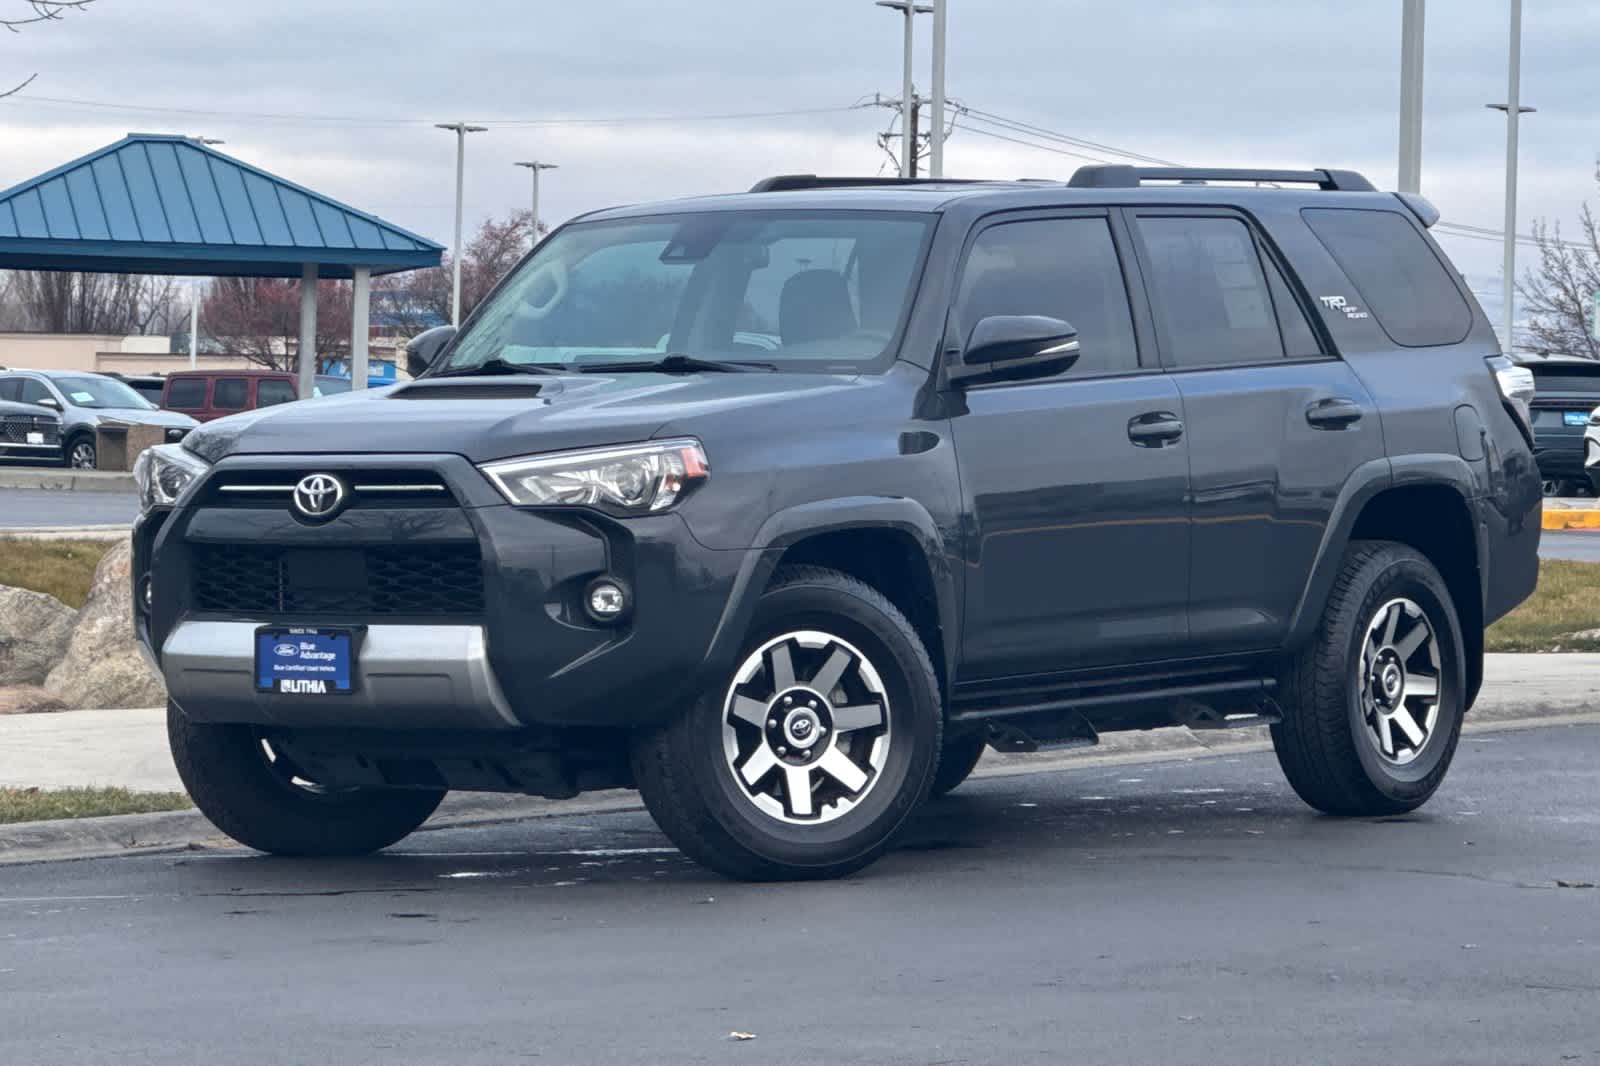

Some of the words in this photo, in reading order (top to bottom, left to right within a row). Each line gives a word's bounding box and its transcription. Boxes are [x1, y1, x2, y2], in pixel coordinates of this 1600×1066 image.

[1320, 296, 1347, 310] TRD
[300, 642, 315, 650] Blue
[300, 652, 336, 661] Advantage
[291, 680, 327, 693] LITHIA
